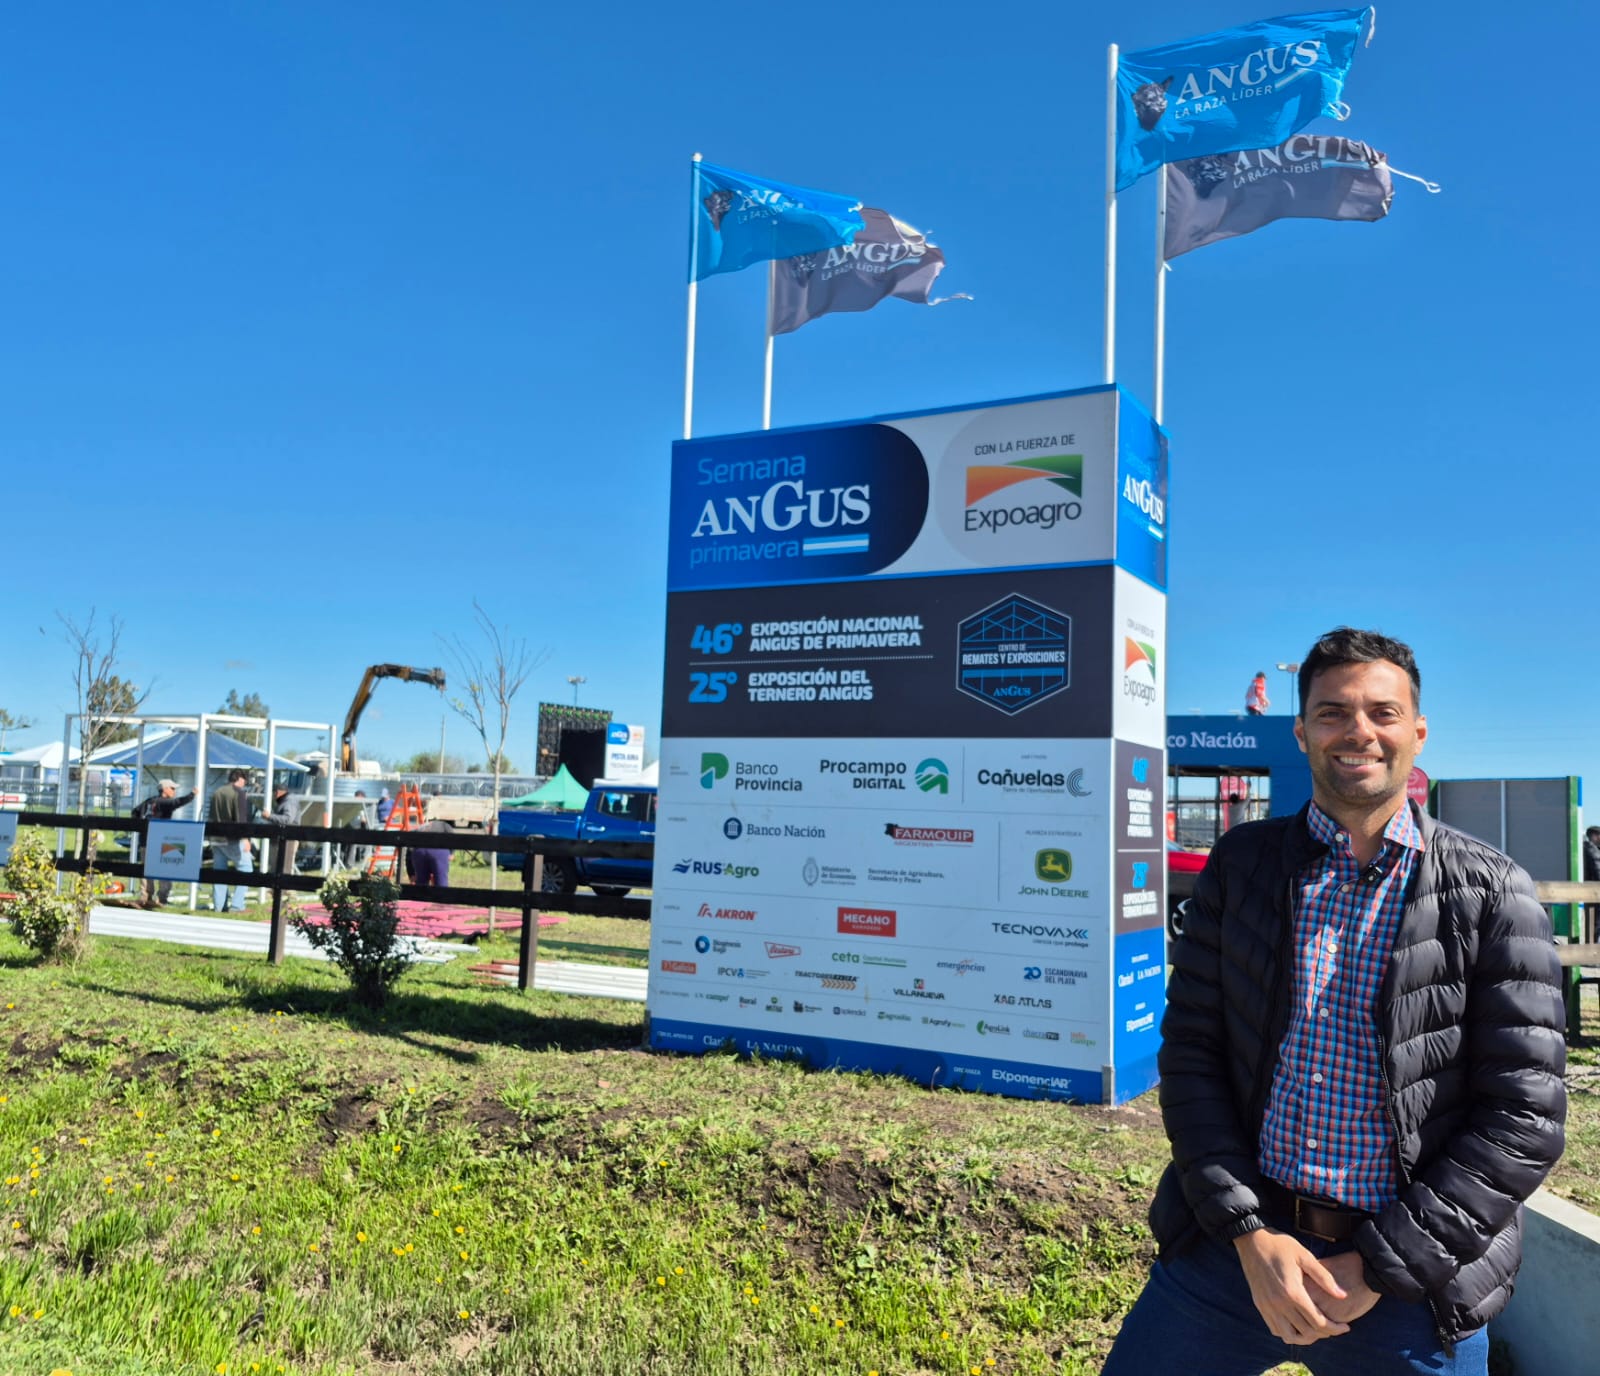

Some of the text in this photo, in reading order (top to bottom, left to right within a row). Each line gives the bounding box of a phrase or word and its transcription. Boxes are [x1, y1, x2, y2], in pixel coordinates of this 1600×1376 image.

[1175, 40, 1320, 105] ANGUS
[1195, 96, 1226, 114] RAZA
[1232, 85, 1272, 101] LÍDER
[1248, 167, 1277, 182] RAZA
[822, 242, 926, 269] ANGUS
[974, 434, 1076, 456] CON LA FUERZA DE
[698, 455, 806, 485] Semana
[1123, 473, 1164, 525] ANGUS
[690, 480, 871, 537] ANGUS
[964, 501, 1082, 533] Expoagro
[689, 539, 800, 569] primavera
[751, 616, 924, 636] EXPOSICIÓN NACIONAL
[749, 632, 922, 652] ANGUS DE PRIMAVERA
[962, 651, 1066, 665] REMATES Y EXPOSICIONES
[748, 667, 870, 687] EXPOSICIÓN DEL
[748, 686, 873, 702] TERNERO ANGUS
[993, 685, 1031, 697] ANGUS
[1123, 675, 1156, 706] Expoagro
[1167, 732, 1257, 749] co Nación
[735, 761, 778, 775] Banco
[820, 759, 907, 777] Procampo
[735, 777, 803, 792] Provincia
[853, 777, 906, 790] DIGITAL
[977, 768, 1065, 787] Cañuelas
[747, 823, 826, 839] Banco Nación
[895, 828, 974, 842] FARMQUIP
[1018, 885, 1089, 898] JOHN DEERE
[715, 908, 756, 921] AKRON
[843, 912, 891, 926] MECANO
[992, 922, 1082, 939] TECNOVAX
[831, 952, 860, 964] ceta
[1024, 966, 1042, 980] 20
[1044, 967, 1088, 978] ESCANDINAVIA
[1044, 976, 1076, 985] DEL PLATA
[893, 987, 946, 1000] VILLANUEVA
[994, 993, 1053, 1009] XAG ATLAS
